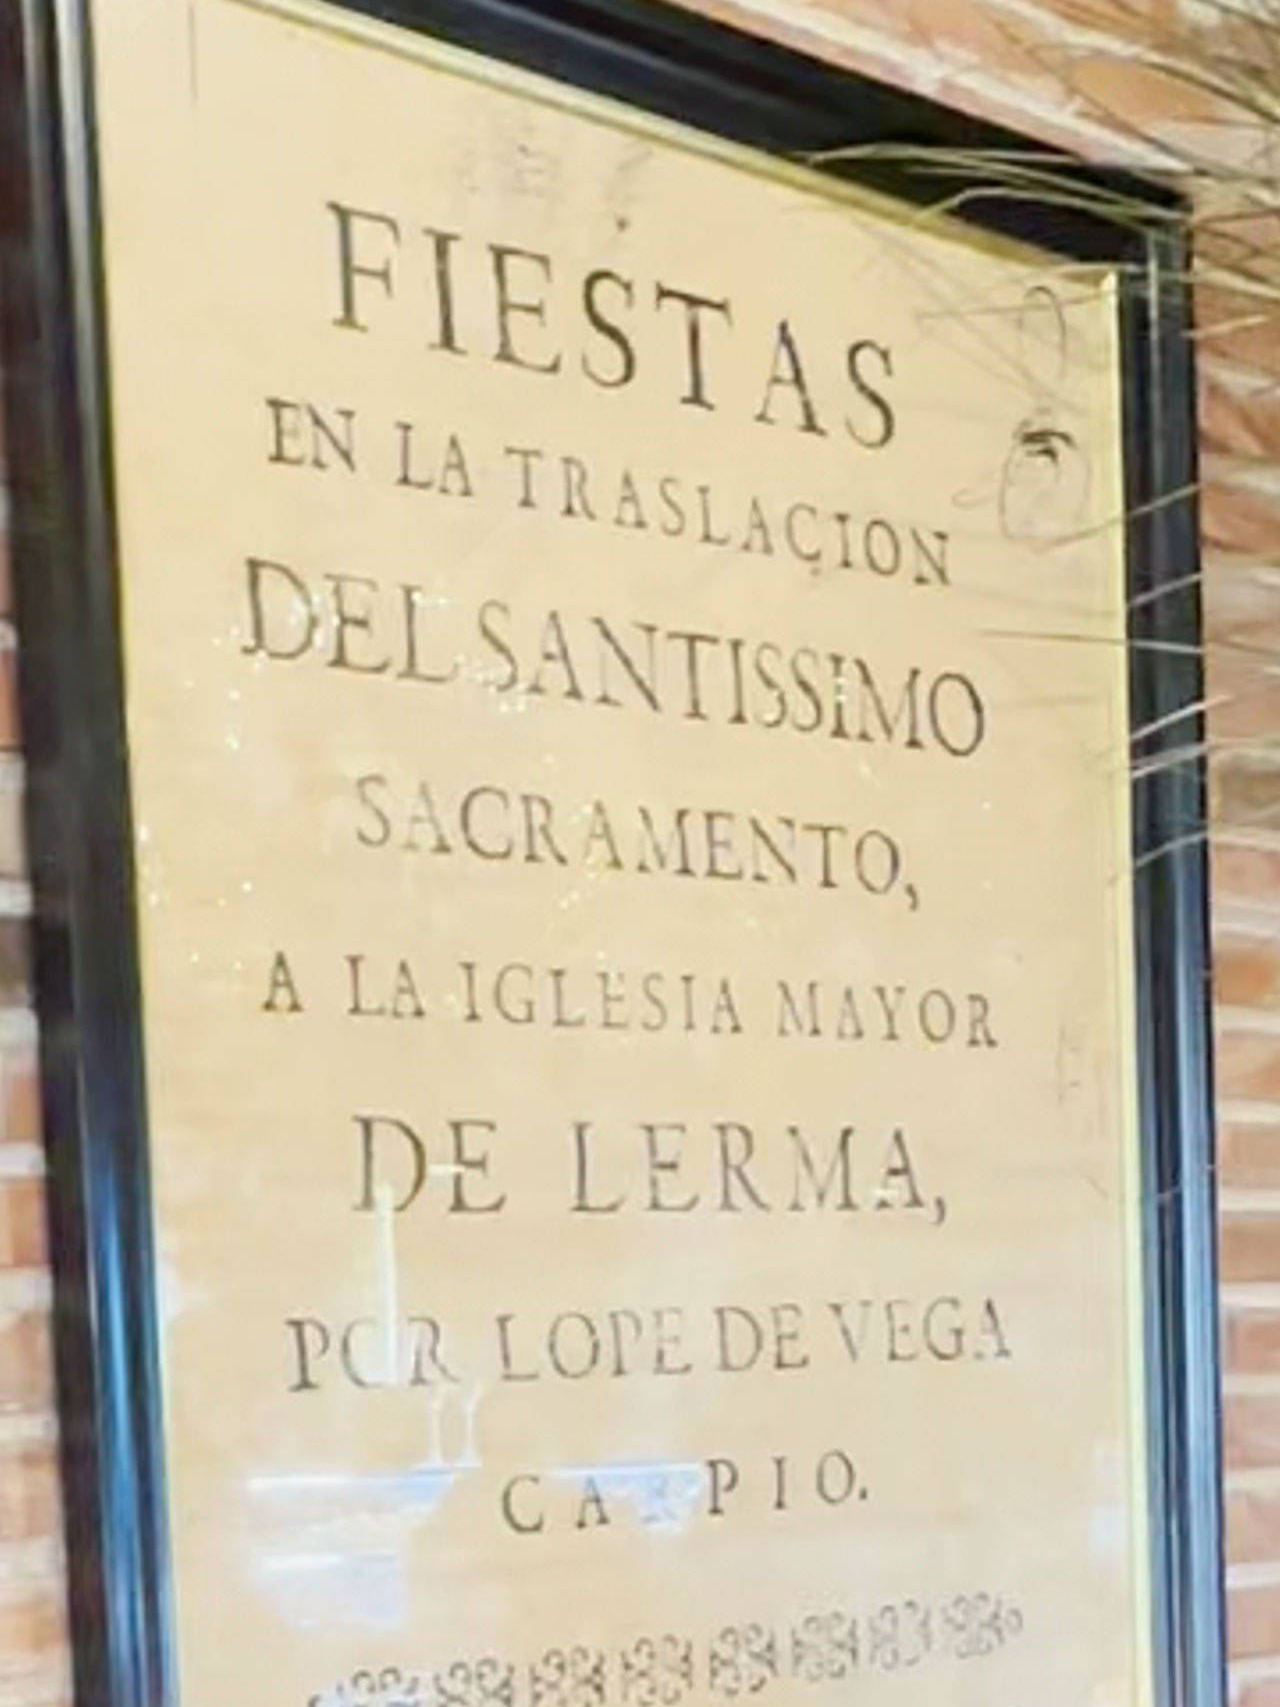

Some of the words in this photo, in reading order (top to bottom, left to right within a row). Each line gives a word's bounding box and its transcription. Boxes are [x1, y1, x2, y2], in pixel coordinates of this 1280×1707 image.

[325, 200, 898, 450] FIESTAS
[265, 396, 356, 474] EN
[394, 420, 474, 498] LA
[241, 557, 462, 685] DEL
[477, 599, 986, 757] SANTISSIMO
[354, 774, 920, 912] SACRAMENTO,
[261, 950, 304, 1013] A
[344, 953, 426, 1021] LA
[459, 960, 744, 1035] IGLESIA
[776, 979, 999, 1049] MAYOR
[351, 1114, 508, 1214] DE
[570, 1120, 948, 1226] LERMA,
[496, 1307, 693, 1383] LOPE
[714, 1303, 810, 1373] DE
[827, 1296, 1012, 1364] VEGA
